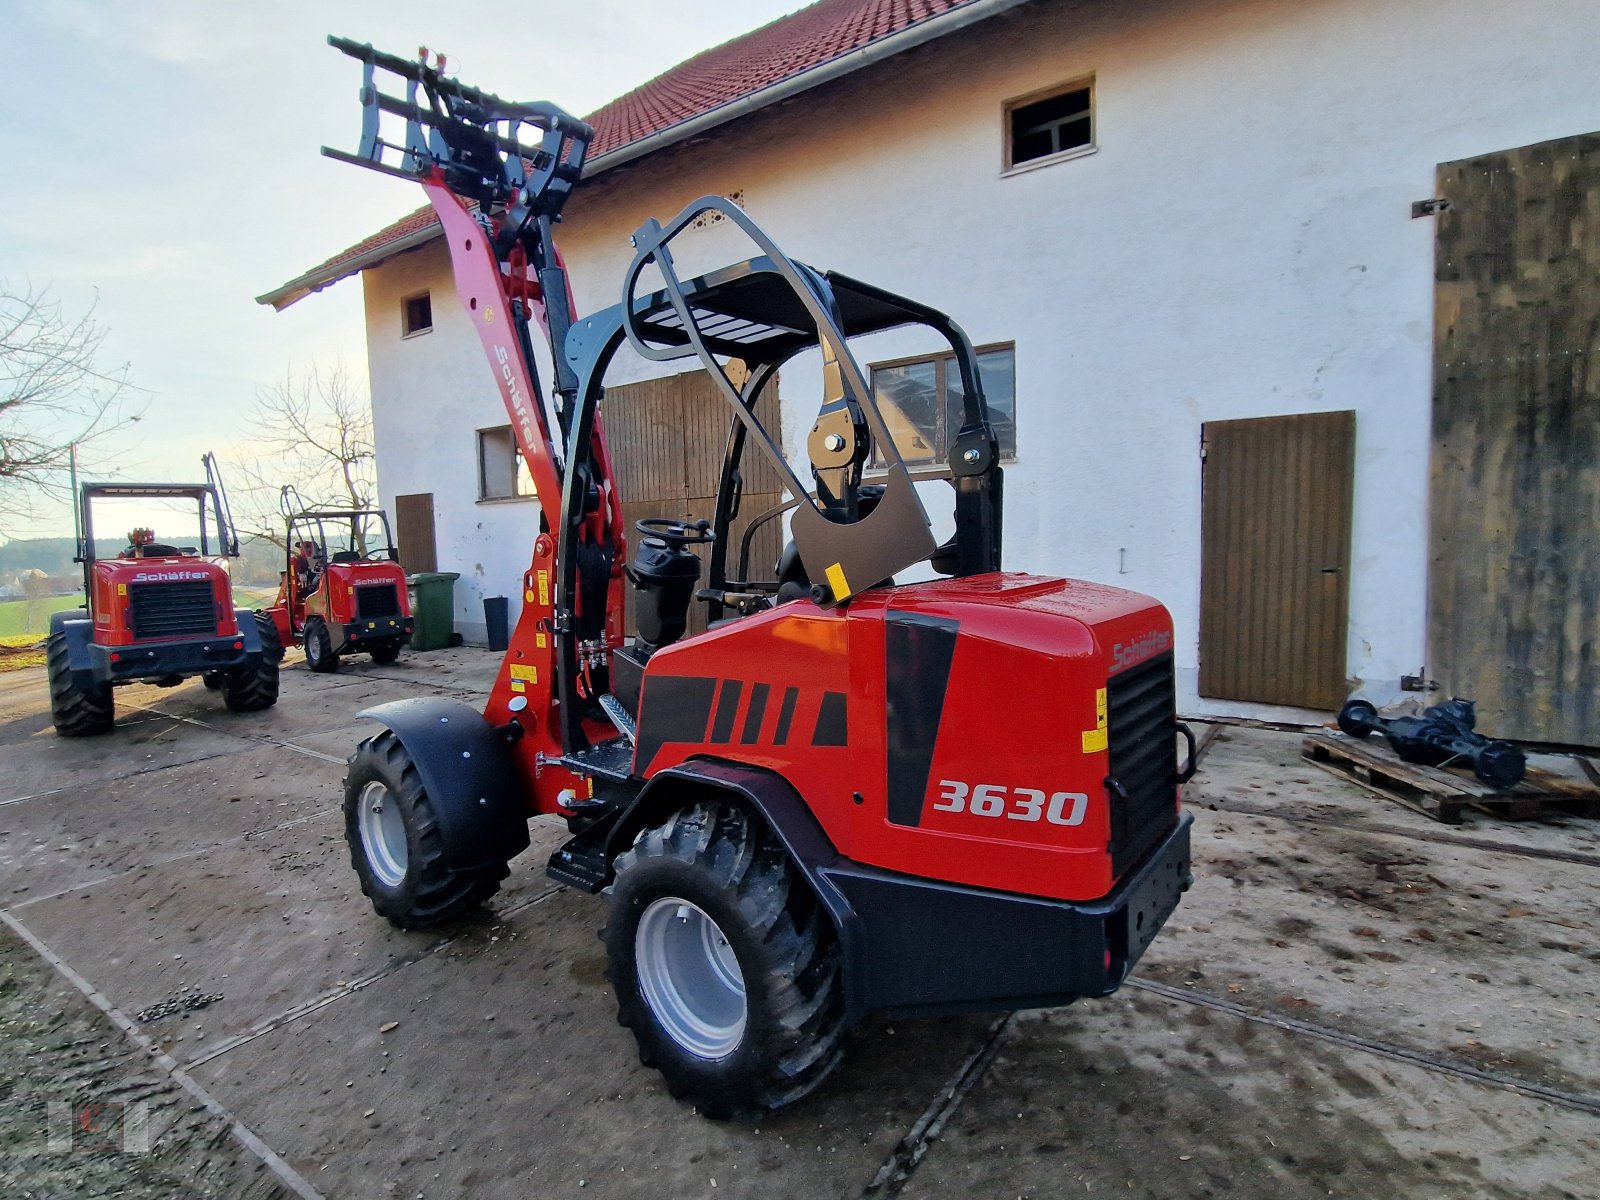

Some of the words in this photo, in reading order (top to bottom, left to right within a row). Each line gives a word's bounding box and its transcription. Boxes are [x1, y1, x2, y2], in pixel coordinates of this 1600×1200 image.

[493, 344, 537, 454] Schäffer
[132, 570, 210, 582] Schäffer
[1108, 629, 1170, 671] Schäffer
[933, 779, 1088, 826] 3630
